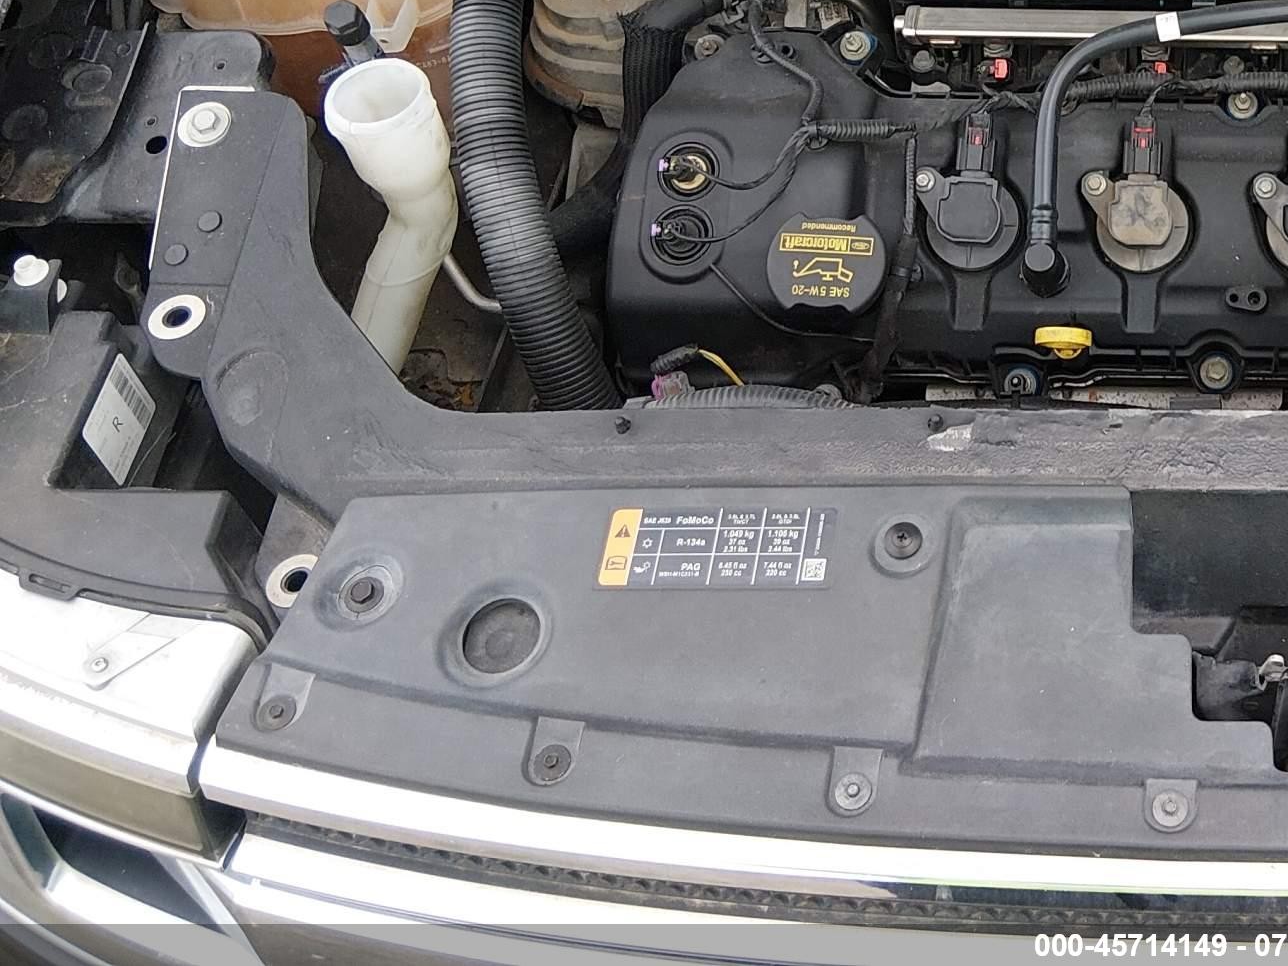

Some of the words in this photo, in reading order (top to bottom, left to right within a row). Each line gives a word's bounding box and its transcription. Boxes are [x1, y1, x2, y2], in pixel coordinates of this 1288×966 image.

[801, 221, 857, 233] Recommended
[784, 235, 849, 252] Motorcraft
[829, 286, 850, 298] SAE
[676, 515, 714, 525] FoMoCo
[723, 529, 744, 538] 1.049
[744, 529, 755, 540] kg
[788, 529, 799, 540] kg
[676, 537, 706, 547] R-134a
[680, 562, 701, 571] PAG
